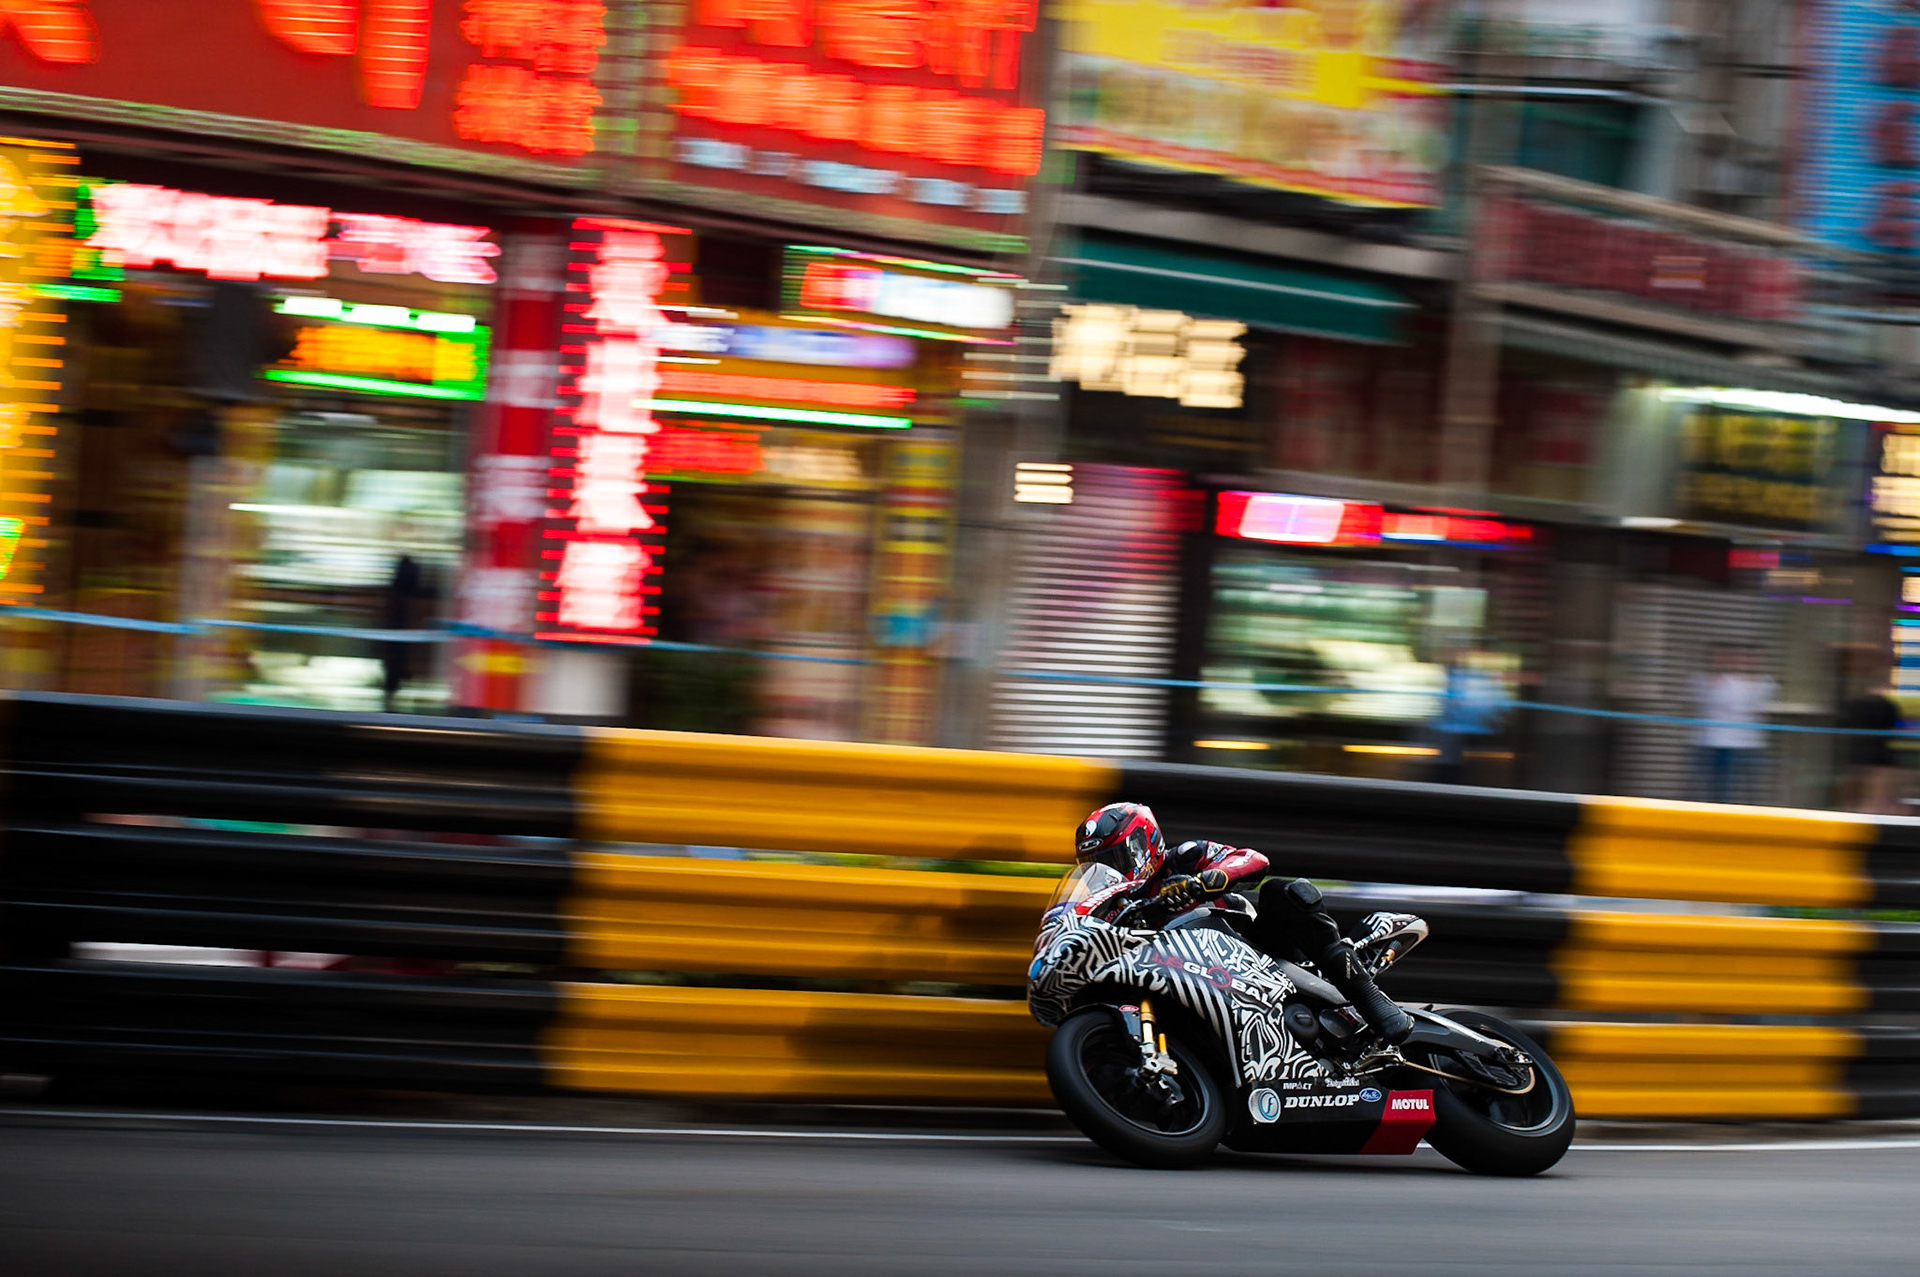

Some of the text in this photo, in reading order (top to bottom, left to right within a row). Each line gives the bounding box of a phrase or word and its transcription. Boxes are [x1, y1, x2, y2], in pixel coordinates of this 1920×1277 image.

[1283, 1082, 1312, 1090] IMPACT
[1284, 1094, 1360, 1108] DUNLOP
[1391, 1098, 1429, 1110] MOTUL
